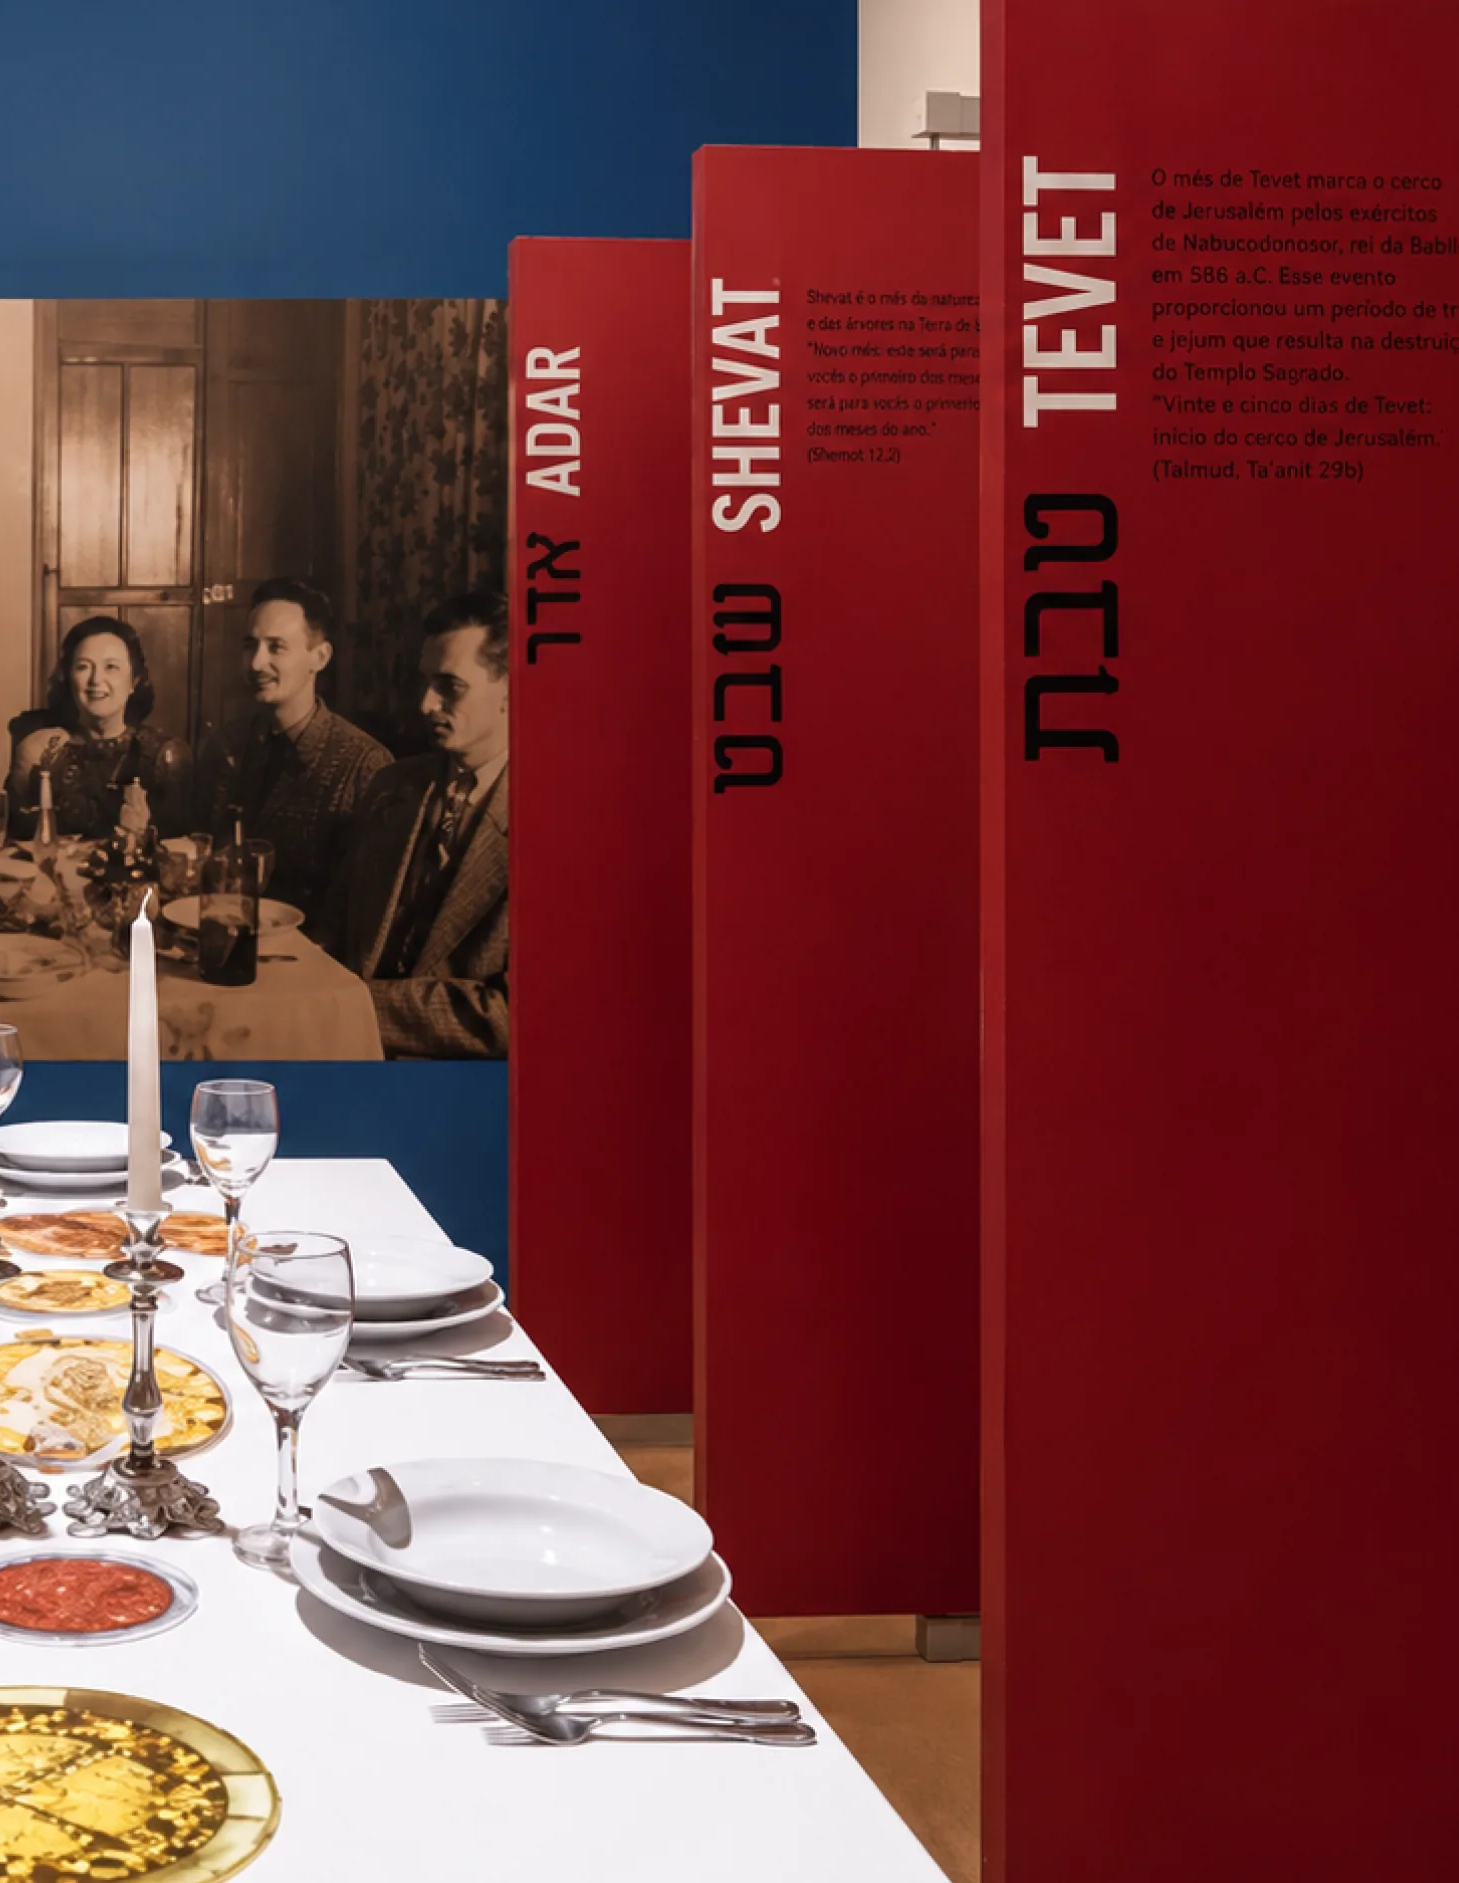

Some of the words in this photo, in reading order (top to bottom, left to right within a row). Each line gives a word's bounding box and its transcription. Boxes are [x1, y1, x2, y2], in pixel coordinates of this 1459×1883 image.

[1151, 168, 1166, 186] O
[1220, 169, 1243, 187] de
[1250, 170, 1300, 188] Tevet
[1307, 175, 1367, 189] marca
[1373, 176, 1385, 189] o
[1391, 176, 1442, 190] cerco
[1152, 200, 1176, 219] de
[1182, 202, 1284, 220] Jerusalém
[1291, 202, 1343, 226] pelos
[1349, 204, 1437, 222] exércitos
[1152, 232, 1175, 251] de
[1184, 233, 1343, 255] Nabucodonosor,
[1350, 236, 1373, 253] rei
[1380, 235, 1403, 254] da
[1411, 235, 1459, 255] Babil
[1151, 269, 1182, 283] em
[1191, 266, 1228, 283] 586
[1236, 266, 1271, 285] a.C.
[1279, 266, 1322, 285] Esse
[1330, 271, 1396, 286] evento
[1023, 156, 1116, 428] TEVET
[1153, 299, 1286, 321] proporcionou
[1294, 304, 1324, 316] um
[1413, 300, 1436, 318] de
[1152, 335, 1163, 348] e
[1170, 331, 1225, 352] jejum
[1233, 335, 1269, 352] que
[1277, 331, 1343, 350] resulta
[1351, 336, 1374, 349] na
[1152, 363, 1177, 381] do
[1184, 362, 1256, 385] Templo
[1263, 363, 1349, 385] Sagrado.
[712, 278, 781, 532] SHEVAT
[1222, 400, 1233, 413] e
[1240, 400, 1291, 414] cinco
[1299, 397, 1337, 413] dias
[1345, 396, 1368, 414] de
[526, 346, 580, 497] ADAR
[1214, 428, 1237, 445] do
[1245, 433, 1297, 446] cerco
[1304, 428, 1327, 446] de
[1153, 460, 1239, 482] (Talmud,
[1319, 461, 1363, 482] 29b)
[526, 532, 581, 665] אדר
[1024, 493, 1119, 763] טבת
[712, 583, 784, 794] שבט
